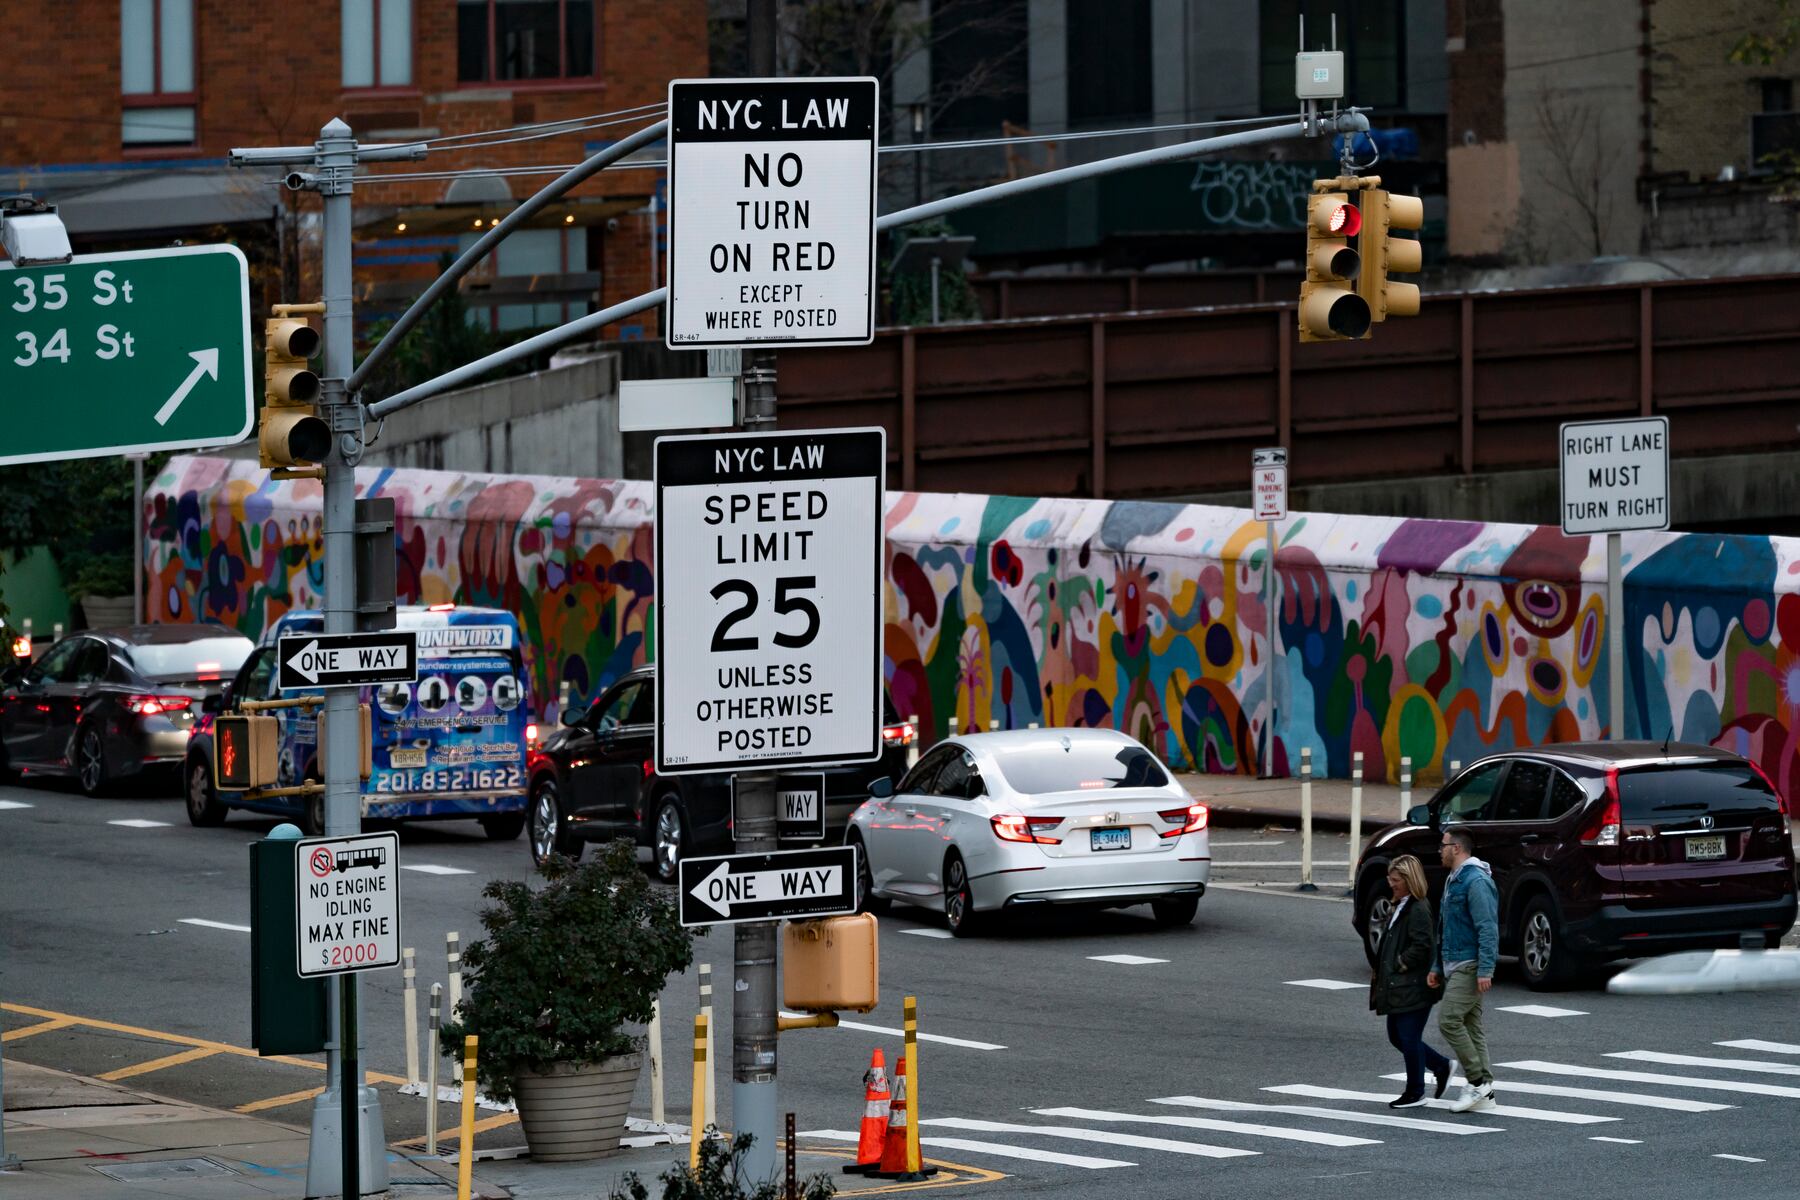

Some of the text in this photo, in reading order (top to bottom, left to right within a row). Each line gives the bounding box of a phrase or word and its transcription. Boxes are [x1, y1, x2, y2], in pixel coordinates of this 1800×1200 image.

[698, 98, 849, 130] NYC LAW
[744, 152, 803, 188] NO
[736, 200, 809, 230] TURN
[710, 242, 835, 273] ON RED
[11, 269, 133, 313] 35 St
[740, 284, 803, 303] EXCEPT
[705, 308, 837, 330] WHERE POSTED
[14, 324, 135, 367] 34 St
[674, 333, 700, 341] SR-467
[1566, 433, 1662, 456] RIGHT LANE
[715, 445, 825, 474] NYC LAW
[1264, 472, 1276, 483] NO
[1588, 465, 1641, 488] MUST
[704, 490, 828, 525] SPEED
[1567, 497, 1664, 520] TURN RIGHT
[717, 530, 814, 565] LIMIT
[709, 575, 821, 653] 25
[418, 629, 503, 648] UNDWORX
[301, 648, 399, 672] ONE WAY
[718, 663, 813, 689] UNLESS
[696, 693, 834, 722] OTHERWISE
[718, 725, 812, 752] POSTED
[665, 756, 689, 764] SR-2167
[377, 768, 520, 792] 201.832.1622
[785, 794, 812, 819] WAY
[310, 875, 387, 899] NO ENGINE
[708, 869, 832, 903] ONE WAY
[326, 897, 372, 917] IDLING
[309, 917, 389, 944] MAX FINE
